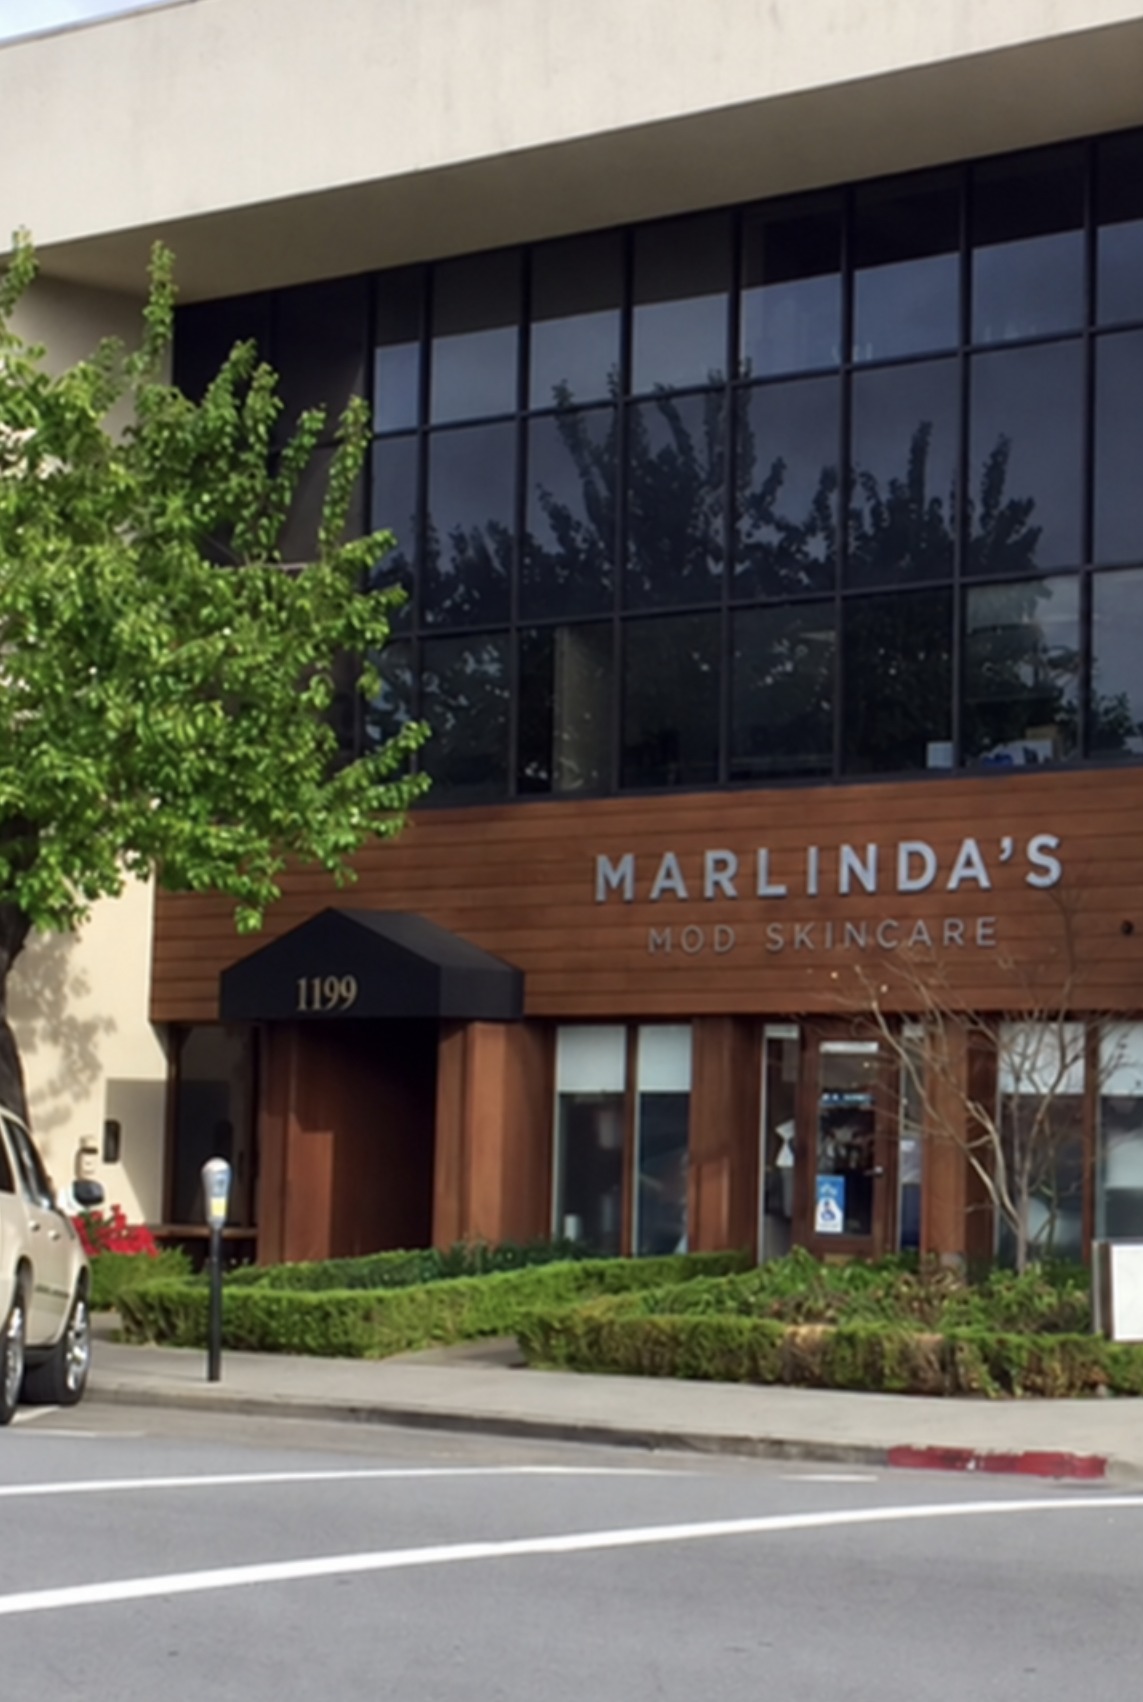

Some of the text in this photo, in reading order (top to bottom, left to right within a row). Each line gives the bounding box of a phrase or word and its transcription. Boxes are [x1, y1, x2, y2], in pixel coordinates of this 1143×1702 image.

[594, 834, 1063, 902] MARLINDA'S
[648, 916, 997, 955] MOD SKINCARE
[296, 974, 358, 1012] 1199
